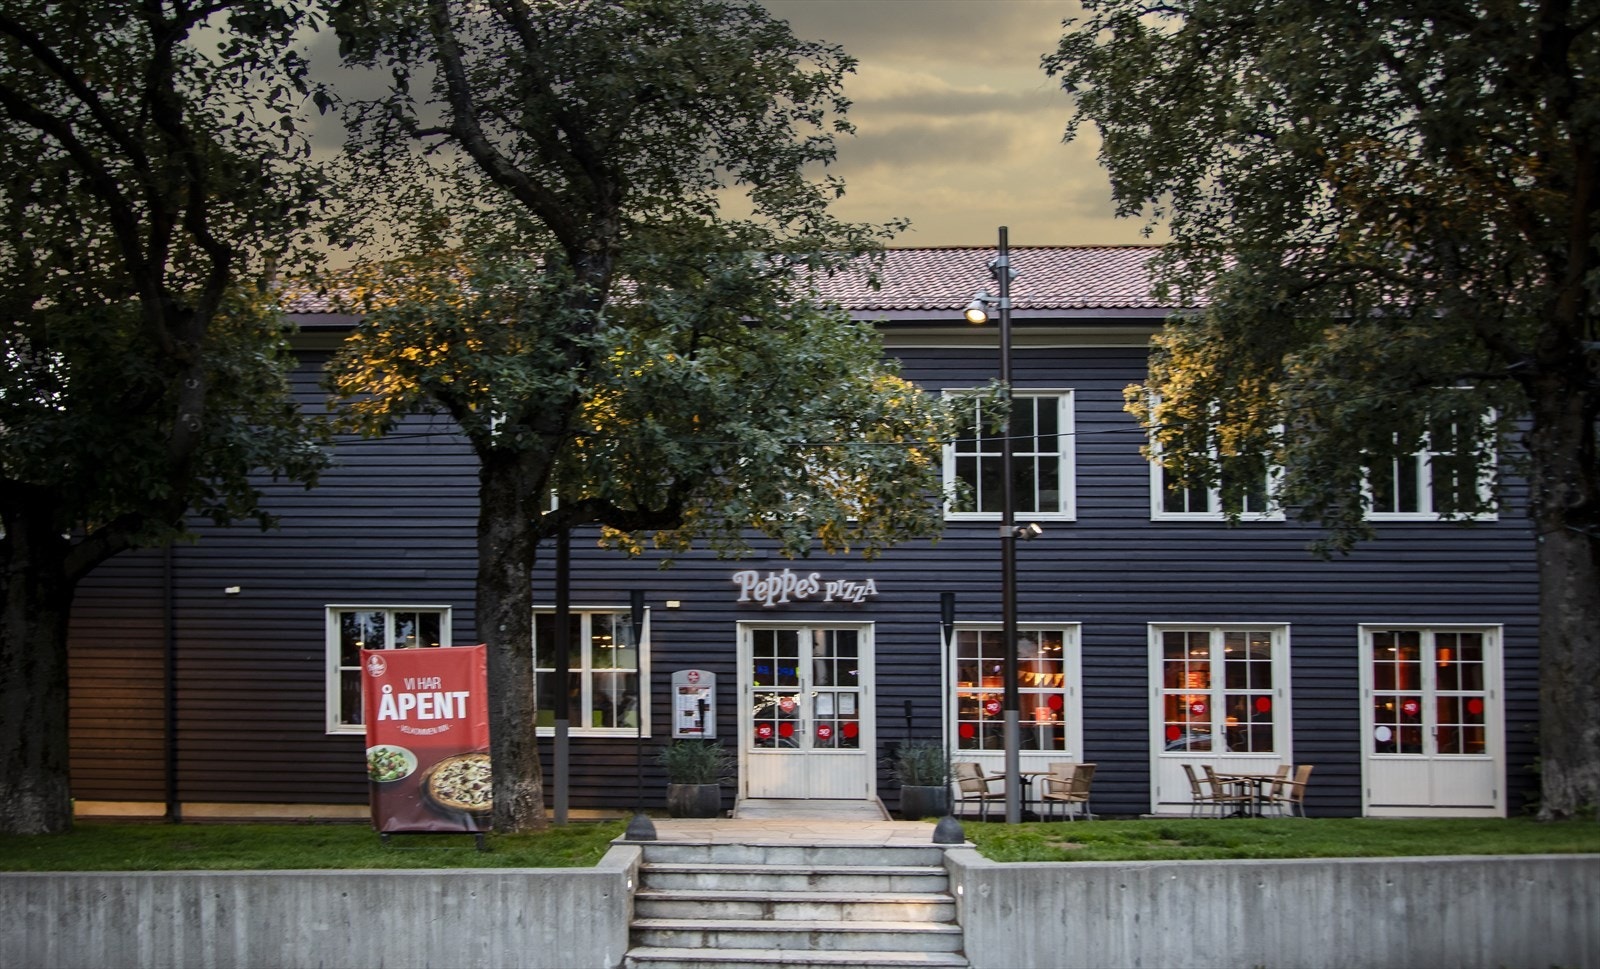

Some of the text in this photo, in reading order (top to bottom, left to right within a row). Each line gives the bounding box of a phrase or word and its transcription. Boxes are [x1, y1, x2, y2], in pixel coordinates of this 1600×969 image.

[732, 568, 879, 607] Peppes PIZZA
[404, 676, 442, 690] VI HAR
[377, 684, 470, 721] ÅPENT
